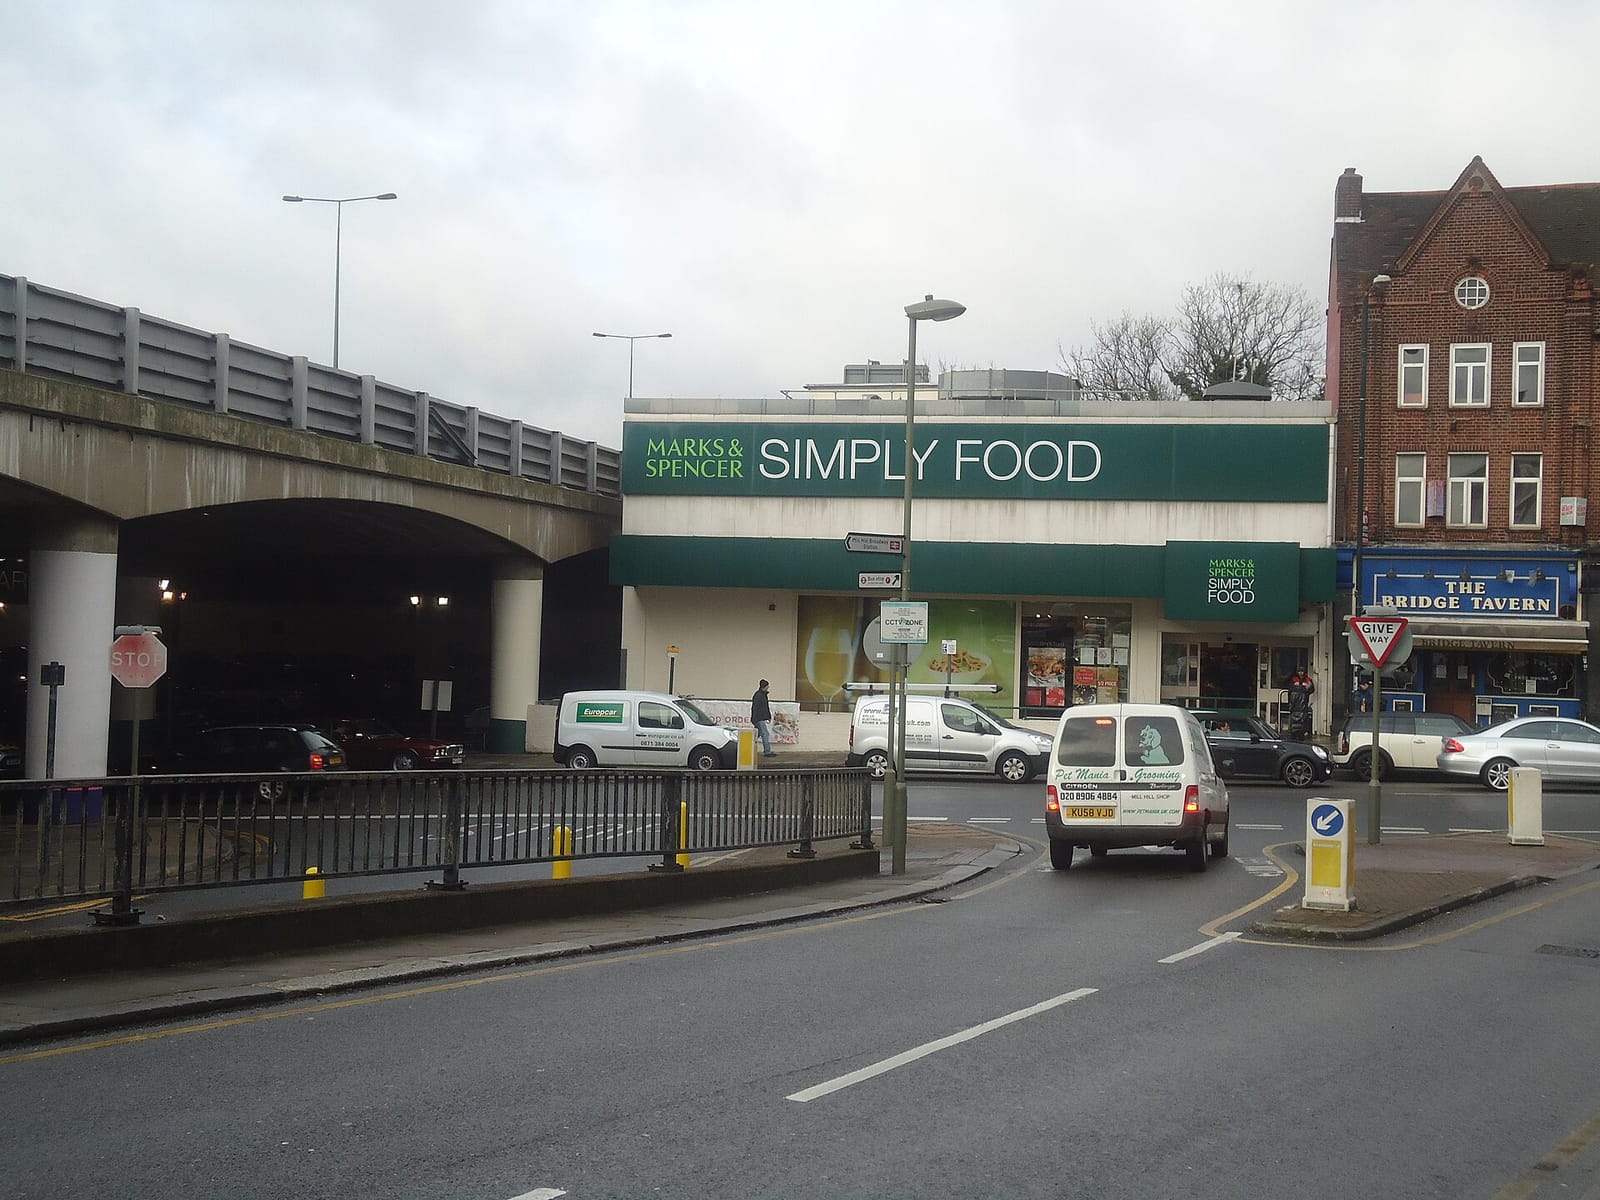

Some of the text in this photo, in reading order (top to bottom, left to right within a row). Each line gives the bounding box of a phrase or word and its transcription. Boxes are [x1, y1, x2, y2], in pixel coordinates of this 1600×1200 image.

[647, 438, 743, 457] MARKS &
[758, 438, 1103, 482] SIMPLY FOOD
[646, 459, 743, 478] SPENCER
[1210, 559, 1255, 568] MARKS &
[1209, 568, 1255, 577] SPENCER
[1208, 578, 1255, 589] SIMPLY
[1445, 581, 1485, 594] THE
[1208, 590, 1255, 603] FOOD
[1382, 595, 1550, 611] BRIDGE TAVERN
[1362, 624, 1394, 633] GIVE
[1422, 638, 1515, 649] BRIDGE TAVERN
[111, 651, 162, 667] STOP
[584, 708, 617, 717] Europcar
[724, 716, 750, 724] ORDE
[1055, 768, 1180, 783] Pet Mania Grooming
[1060, 792, 1117, 800] 020 8906 4884
[1072, 808, 1113, 817] KU58 VJD
